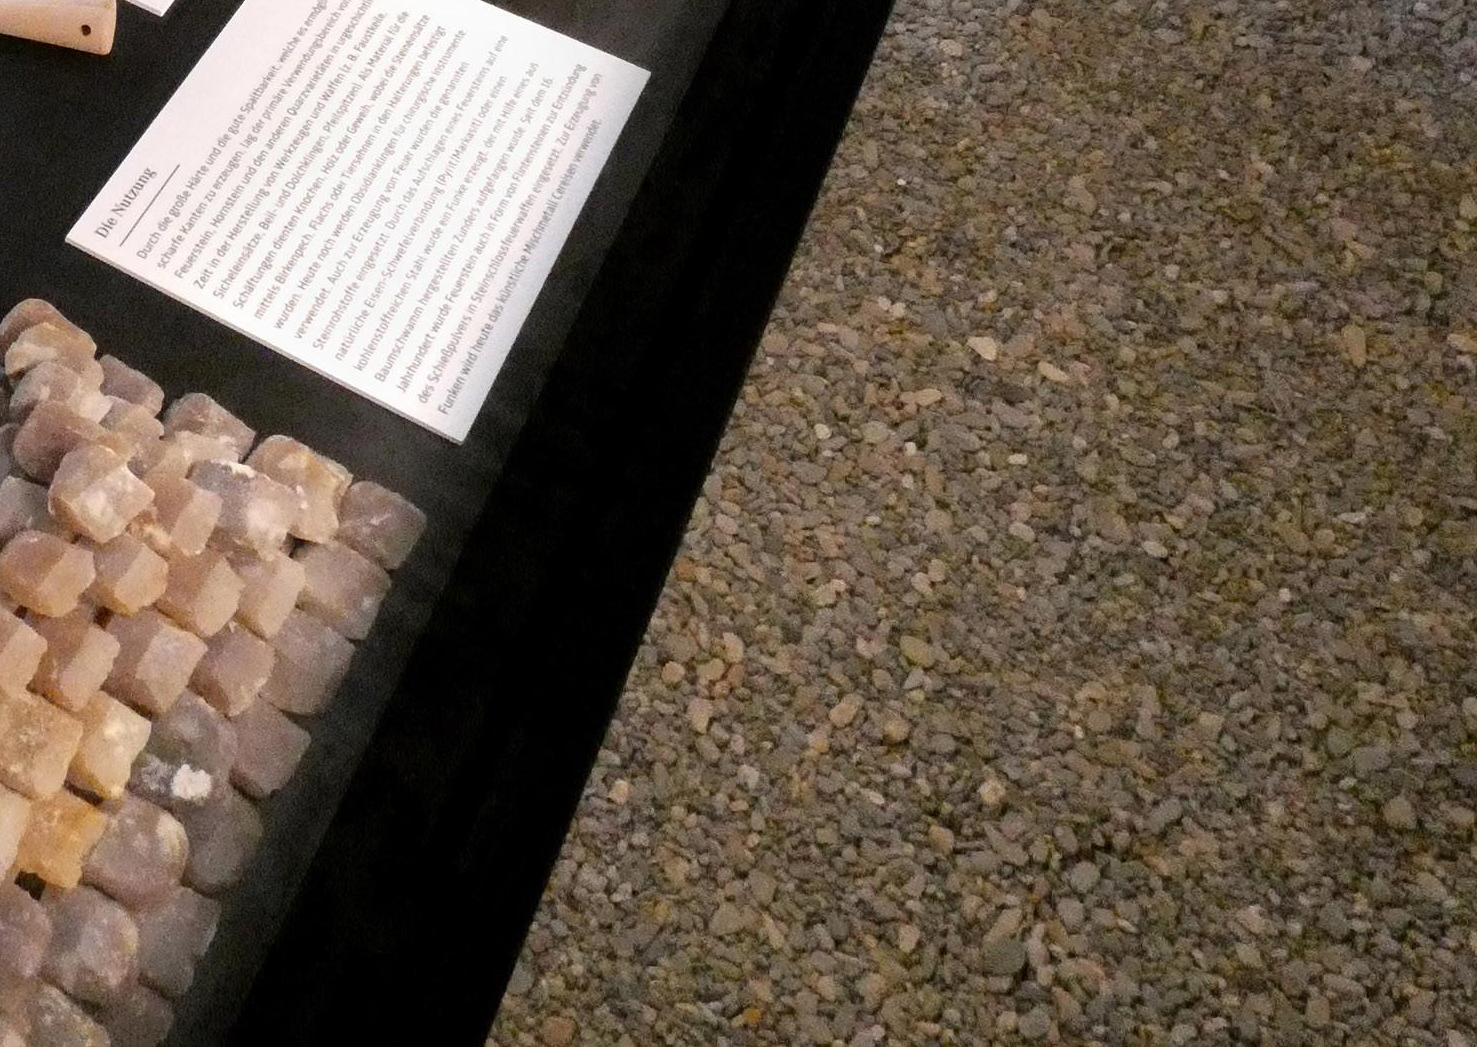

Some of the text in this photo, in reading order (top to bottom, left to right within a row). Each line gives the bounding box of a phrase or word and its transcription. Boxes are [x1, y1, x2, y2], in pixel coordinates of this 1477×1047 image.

[95, 167, 157, 238] Die Nutzung
[136, 229, 162, 259] Durch
[155, 215, 173, 232] die
[169, 189, 192, 218] große
[185, 164, 209, 190] Härte
[205, 145, 222, 165] und
[215, 132, 232, 148] die
[228, 113, 246, 135] gute
[277, 35, 301, 64] welche
[158, 233, 186, 269] scharfe
[179, 201, 208, 235] Kanten
[204, 189, 217, 202] zu
[239, 133, 258, 148] lag
[249, 118, 266, 134] der
[262, 87, 288, 121] primäre
[193, 266, 213, 289] Zeit
[207, 256, 221, 269] in
[214, 239, 232, 258] der
[225, 187, 270, 241] Herstellung
[263, 169, 279, 188] von
[273, 118, 314, 171] Werkzeugen
[310, 100, 325, 119] und
[319, 72, 345, 102] Waffen
[209, 183, 245, 228] Hornstein
[241, 164, 257, 185] und
[251, 149, 269, 167] den
[265, 115, 292, 150] anderen
[328, 44, 340, 54] in
[232, 14, 429, 309] Schäftungen dienten Holz oder wobei die Steineinsätze
[255, 24, 445, 319] mittels Flachs oder Tiersehnen in den Halterungen befestigt
[258, 10, 409, 230] Beil- und Als Material für die
[296, 123, 406, 291] Heute noch werden Obsidianklingen für
[312, 34, 507, 350] Steinrohstoffe Durch das Aufschlagen eines Feuersteins auf eine
[325, 61, 468, 285] Auch zur Erzeugung von Feuer wurden die genannten
[335, 307, 370, 361] natürliche
[363, 185, 445, 309] Eisen-Schwefelverbindung
[477, 98, 493, 118] oder
[489, 74, 507, 99] einen
[353, 61, 537, 371] kohlenstoffreichen Stahl wurde ein Funke der mit Hilfe eines aus
[374, 87, 546, 382] Baumschwamm hergestellten Zunders aufgefangen Seit dem
[417, 72, 601, 404] des Schießpulvers in Steinschlossfeuerwaffen Zur Erzeugung von
[395, 109, 557, 393] Jahrhundert wurde Feuerstein auch in Form von Flintensteinen zur
[438, 162, 577, 415] Funken wird heute das künstliche Mischmetall Cereisen
